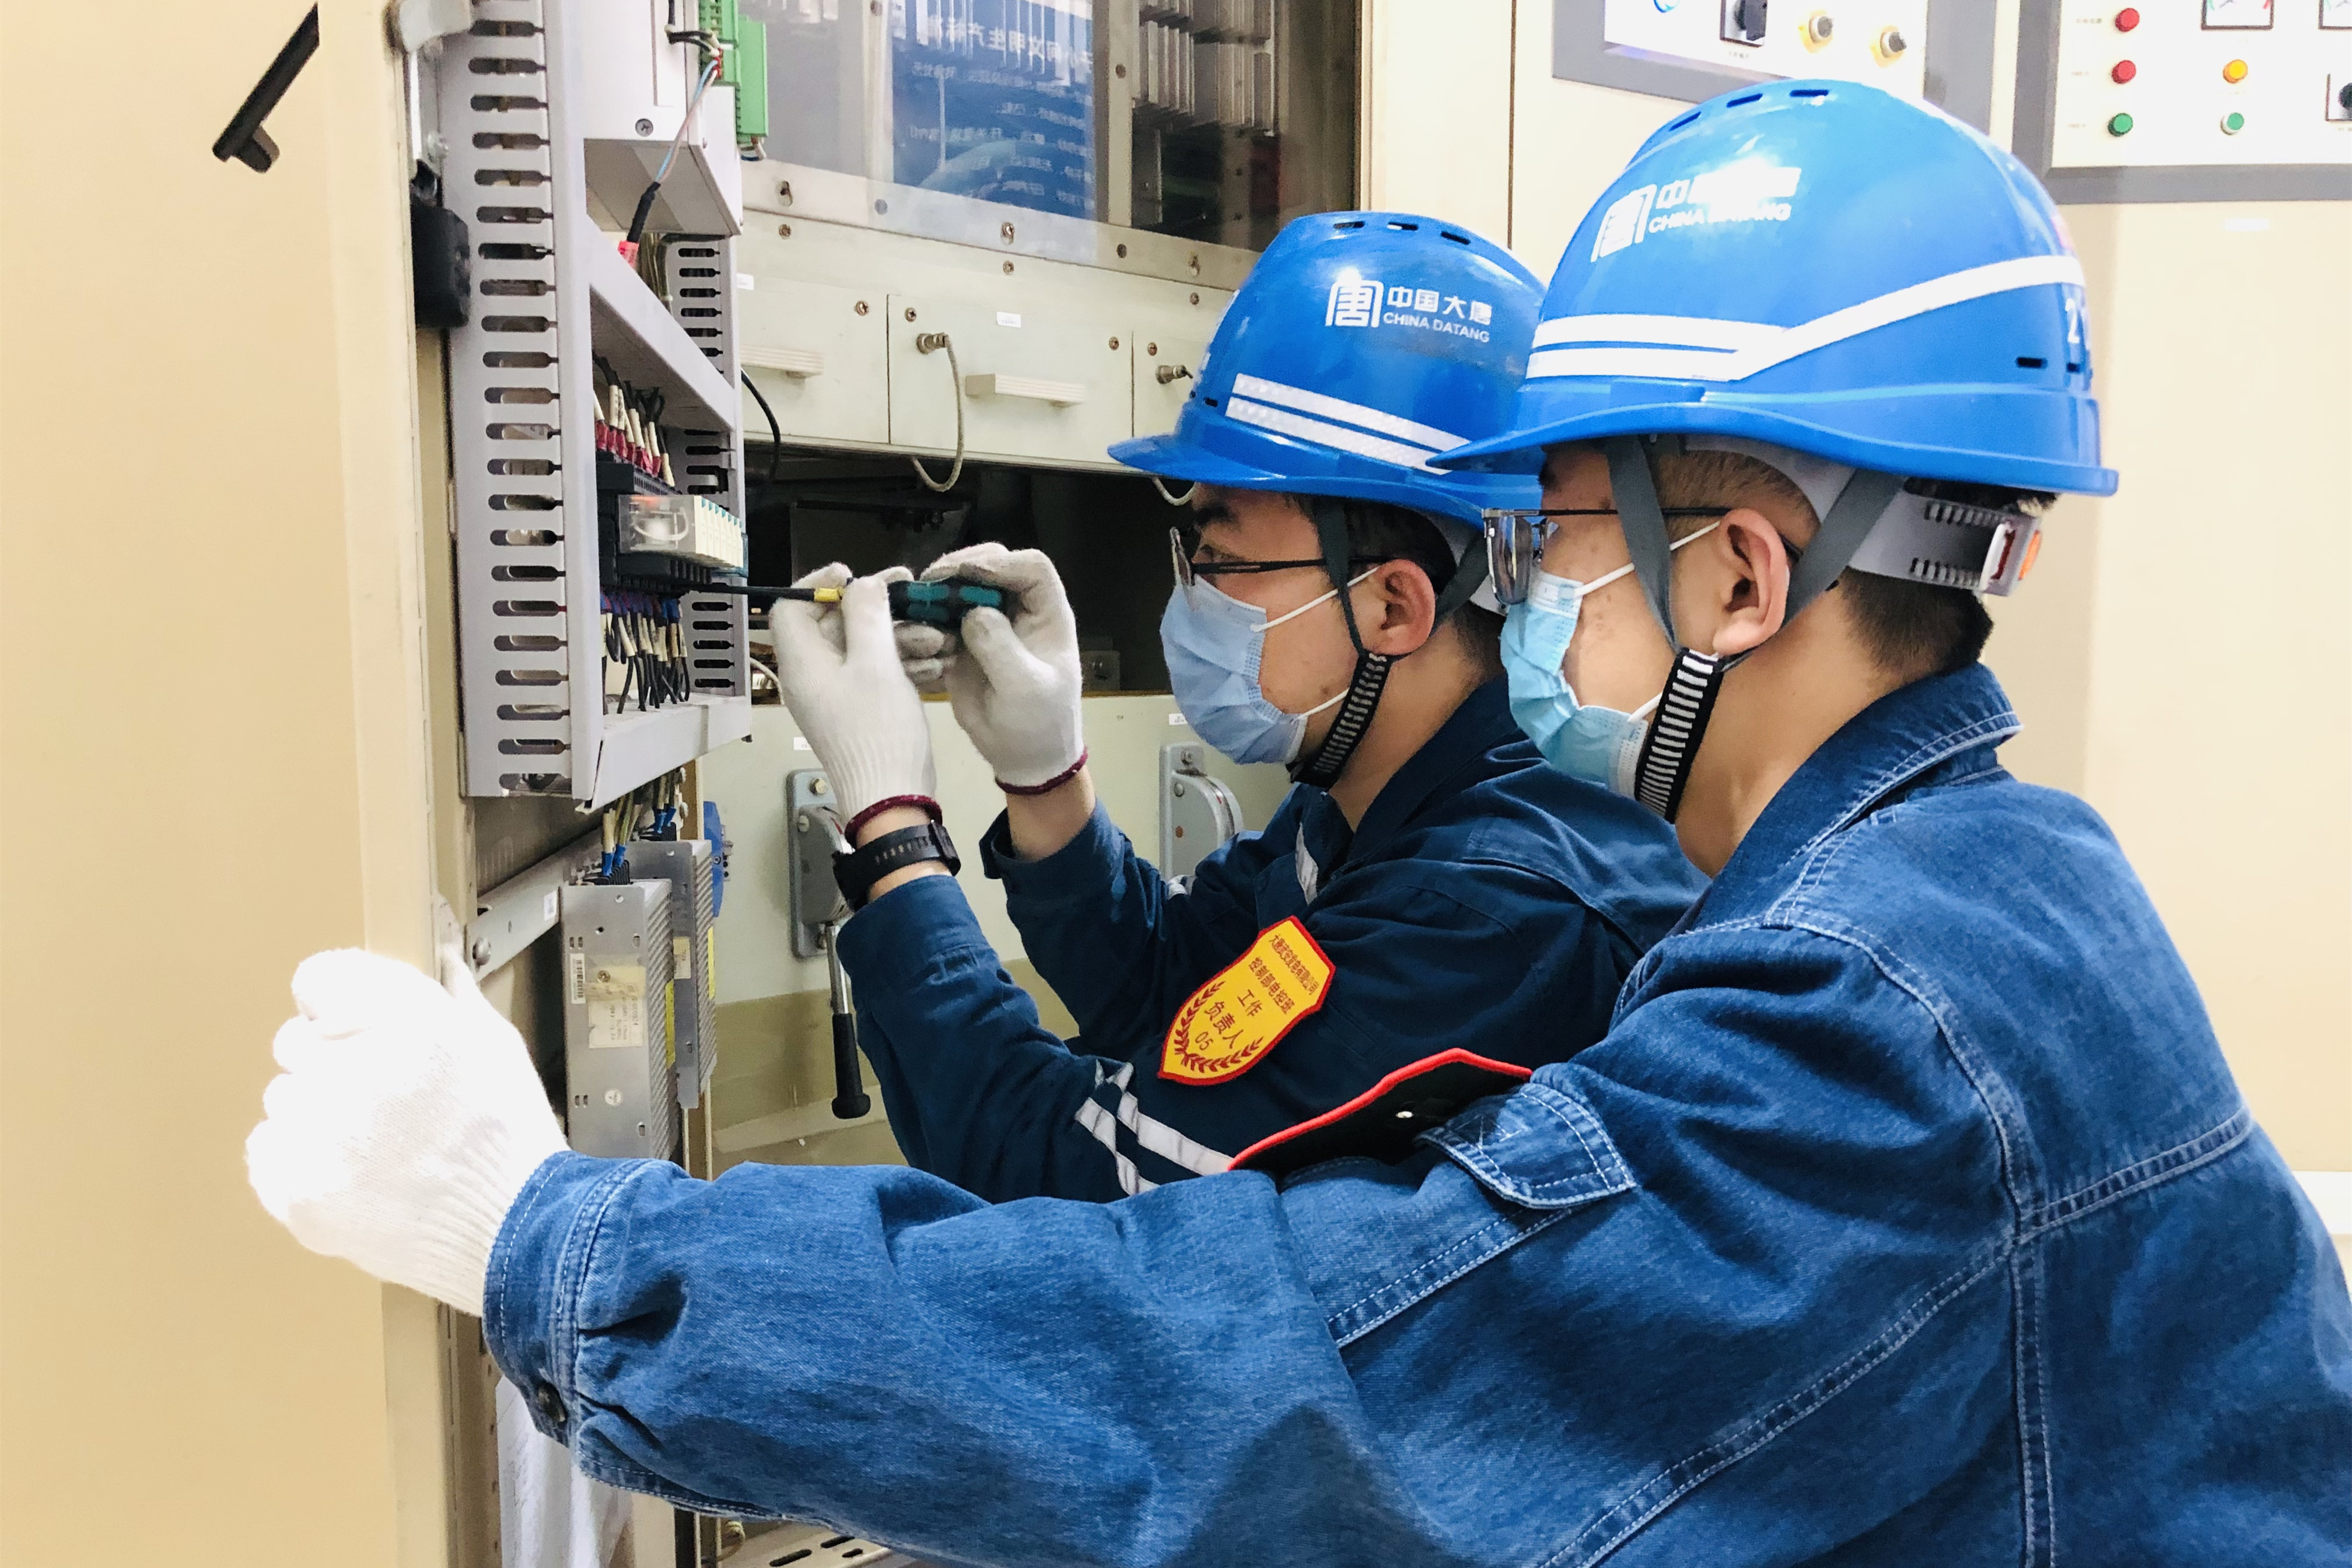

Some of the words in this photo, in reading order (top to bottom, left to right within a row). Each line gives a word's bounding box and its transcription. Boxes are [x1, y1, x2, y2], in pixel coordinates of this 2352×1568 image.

[1648, 208, 1704, 233] CHINA
[1387, 286, 1492, 326] 中国大唐
[1383, 312, 1430, 330] CHINA
[1433, 318, 1490, 343] DATANG
[1237, 989, 1262, 1016] 工作
[1204, 1000, 1244, 1049] 负责人
[1195, 1031, 1213, 1051] 05
